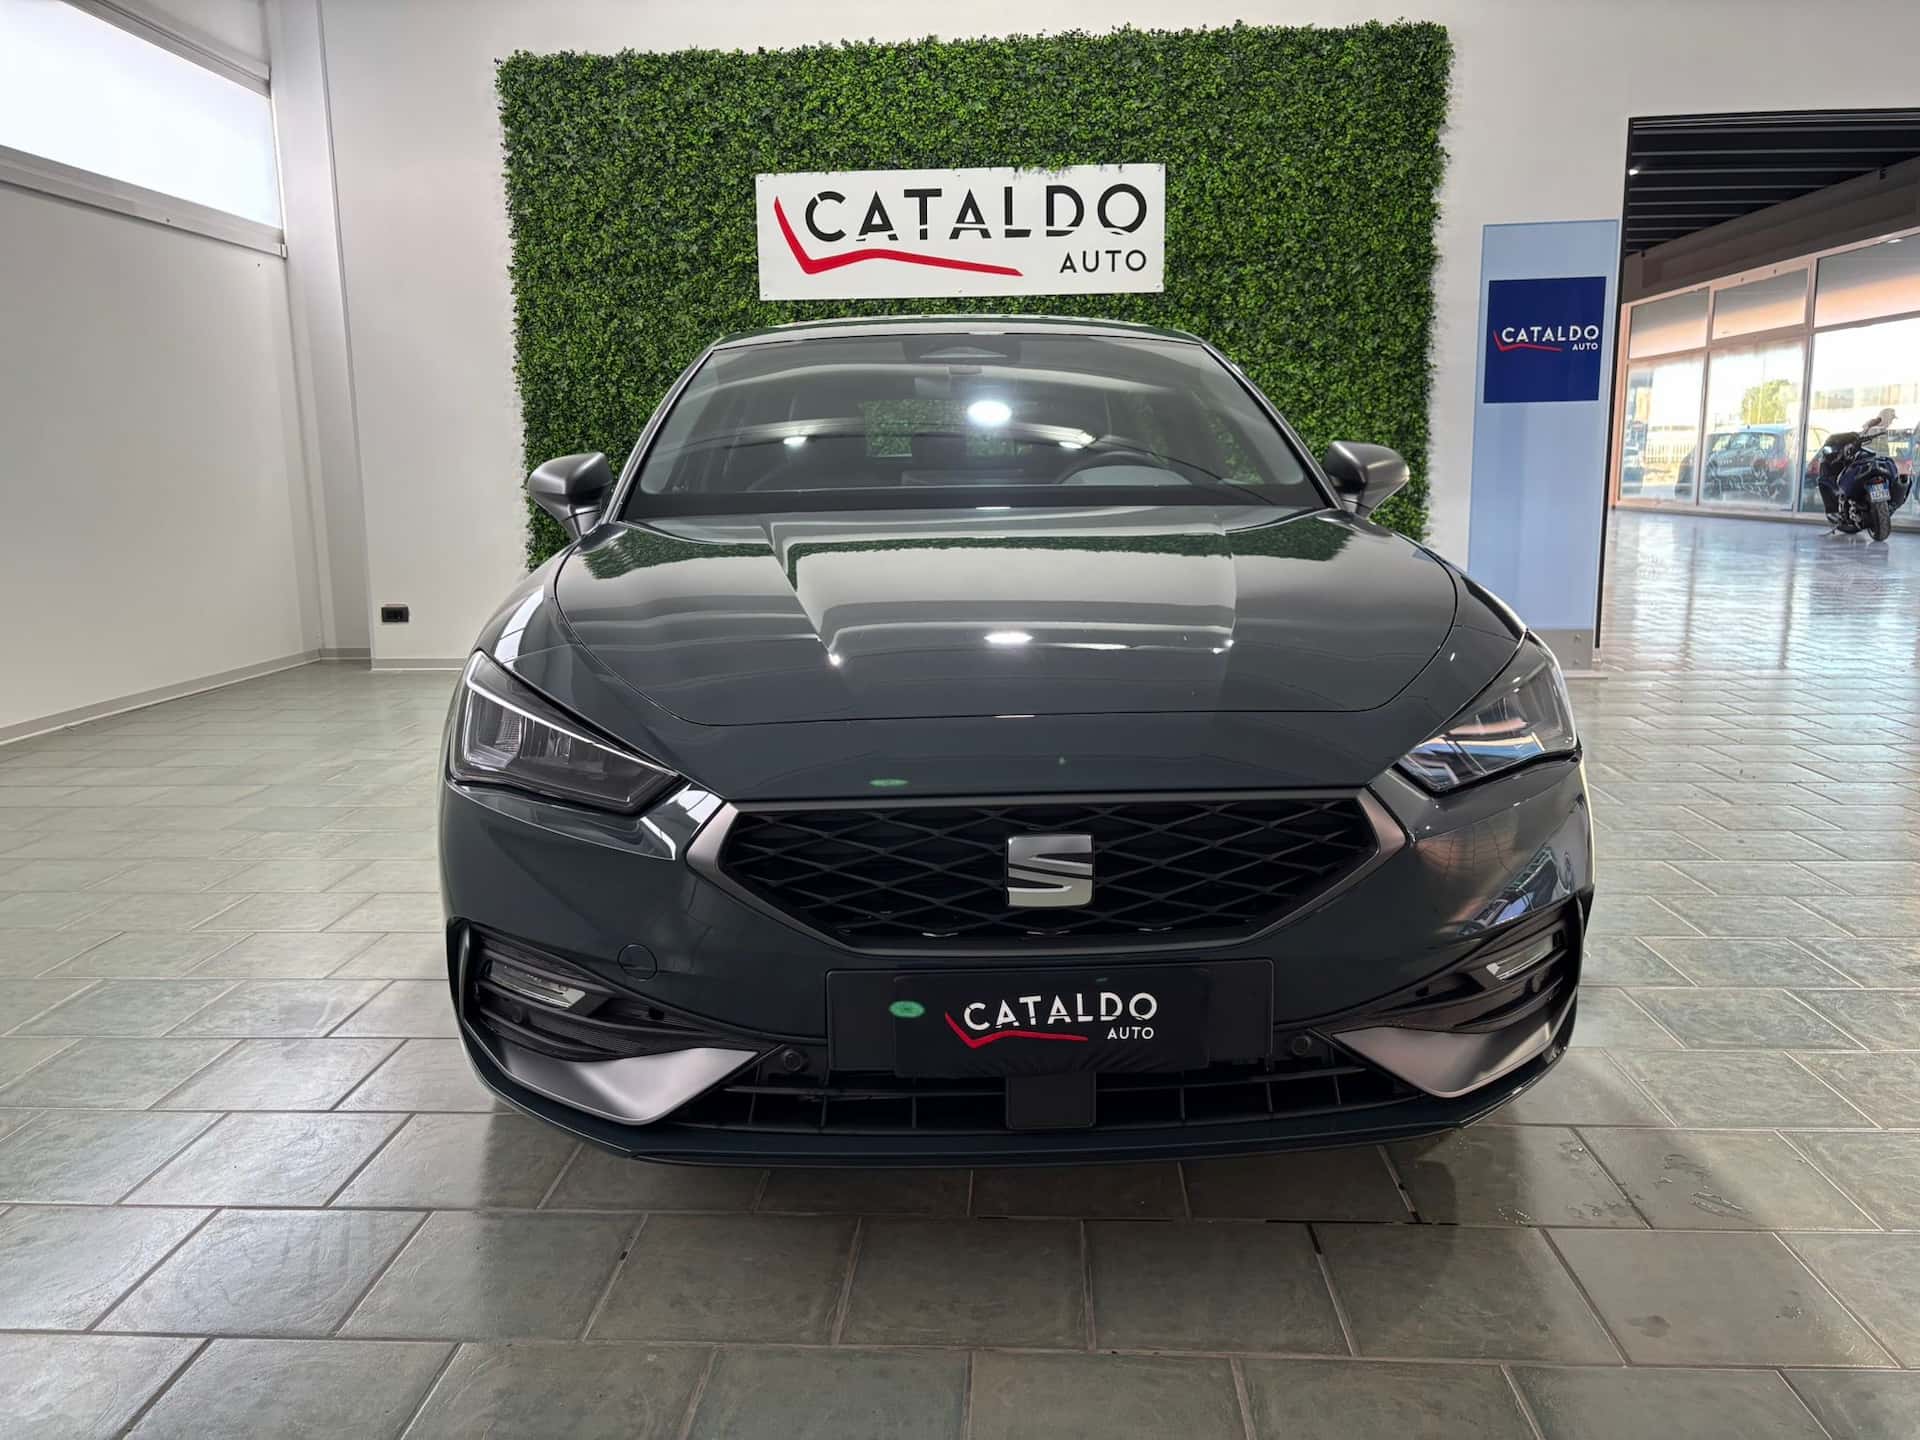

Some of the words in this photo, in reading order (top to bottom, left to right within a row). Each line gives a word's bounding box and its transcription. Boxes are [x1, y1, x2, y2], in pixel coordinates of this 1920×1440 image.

[805, 183, 1148, 243] CATALDO
[1059, 249, 1147, 274] AUTO
[1501, 324, 1600, 343] CATALDO
[1571, 342, 1599, 351] AUTO
[963, 992, 1158, 1031] CATALDO
[1107, 1026, 1155, 1041] AUTO
